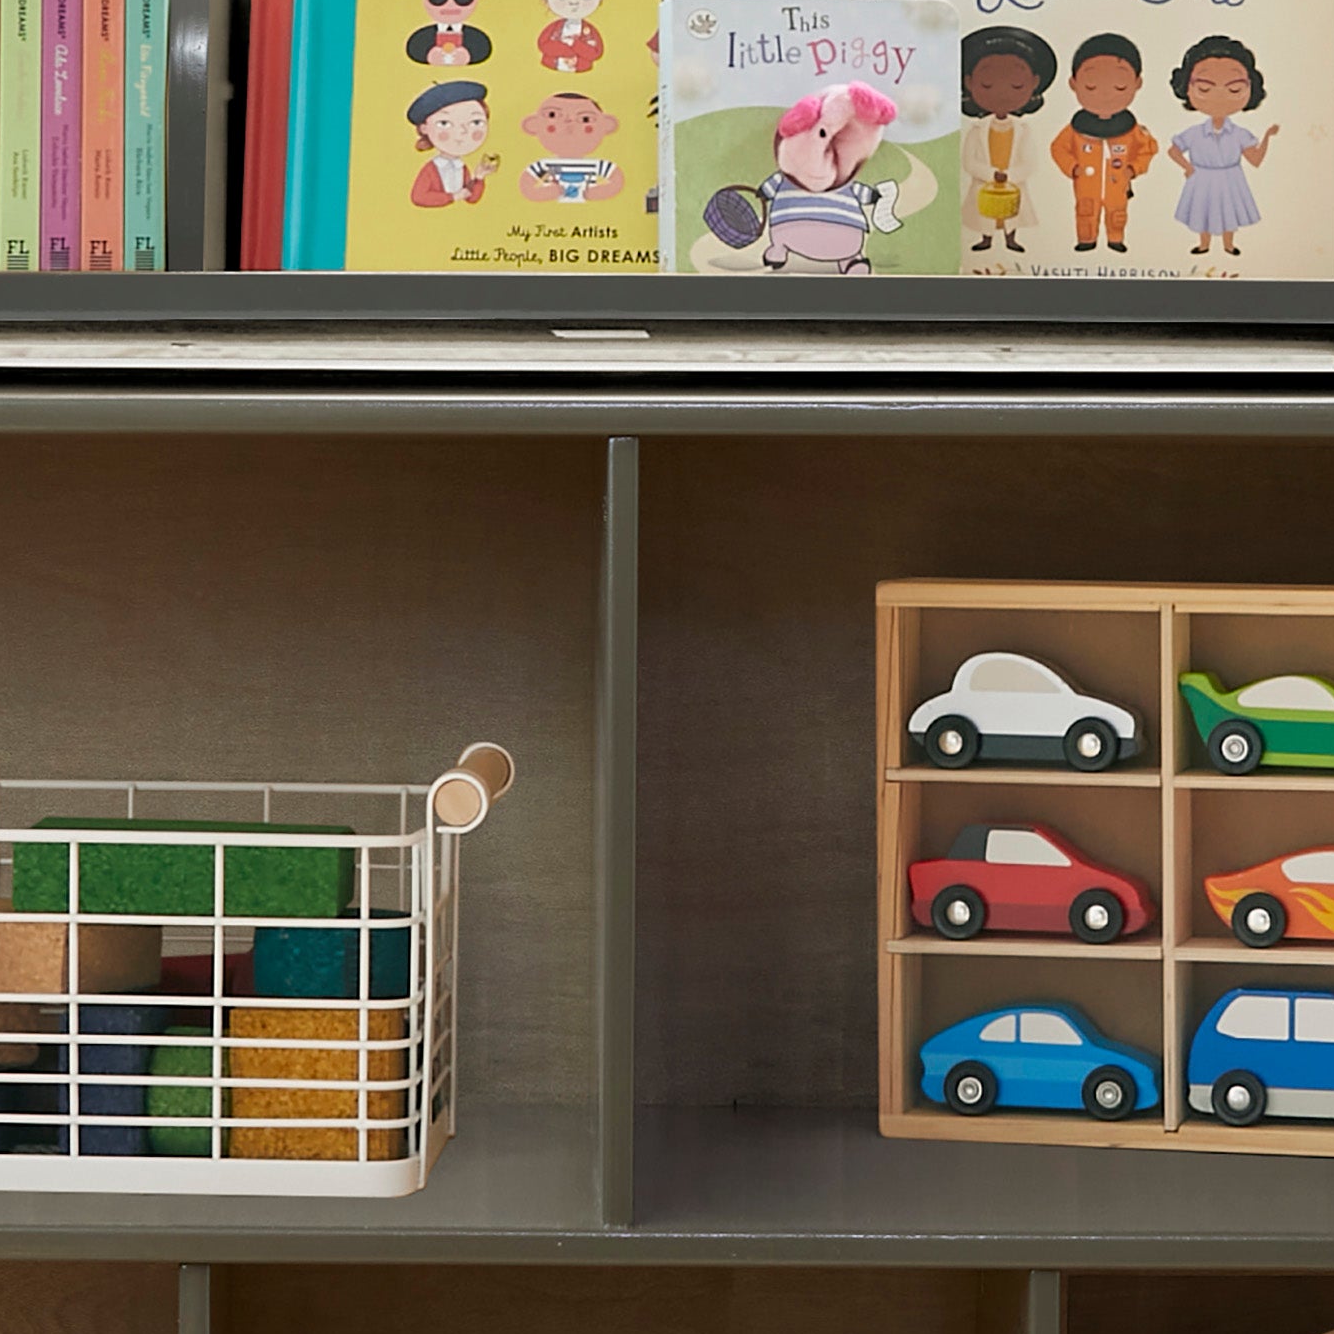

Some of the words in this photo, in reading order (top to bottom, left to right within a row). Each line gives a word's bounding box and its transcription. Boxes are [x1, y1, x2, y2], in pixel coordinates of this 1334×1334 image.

[782, 7, 830, 32] This
[54, 44, 68, 67] Ada
[728, 31, 801, 69] little
[807, 36, 917, 84] piggy
[507, 226, 530, 242] My
[535, 225, 567, 237] First
[571, 226, 618, 238] Artists
[7, 240, 29, 254] FL
[50, 237, 70, 250] FL
[91, 241, 112, 254] FL
[135, 237, 155, 250] FL
[451, 247, 489, 261] Little
[494, 248, 543, 268] People,
[549, 249, 579, 263] BIG
[588, 249, 660, 263] DREAMS
